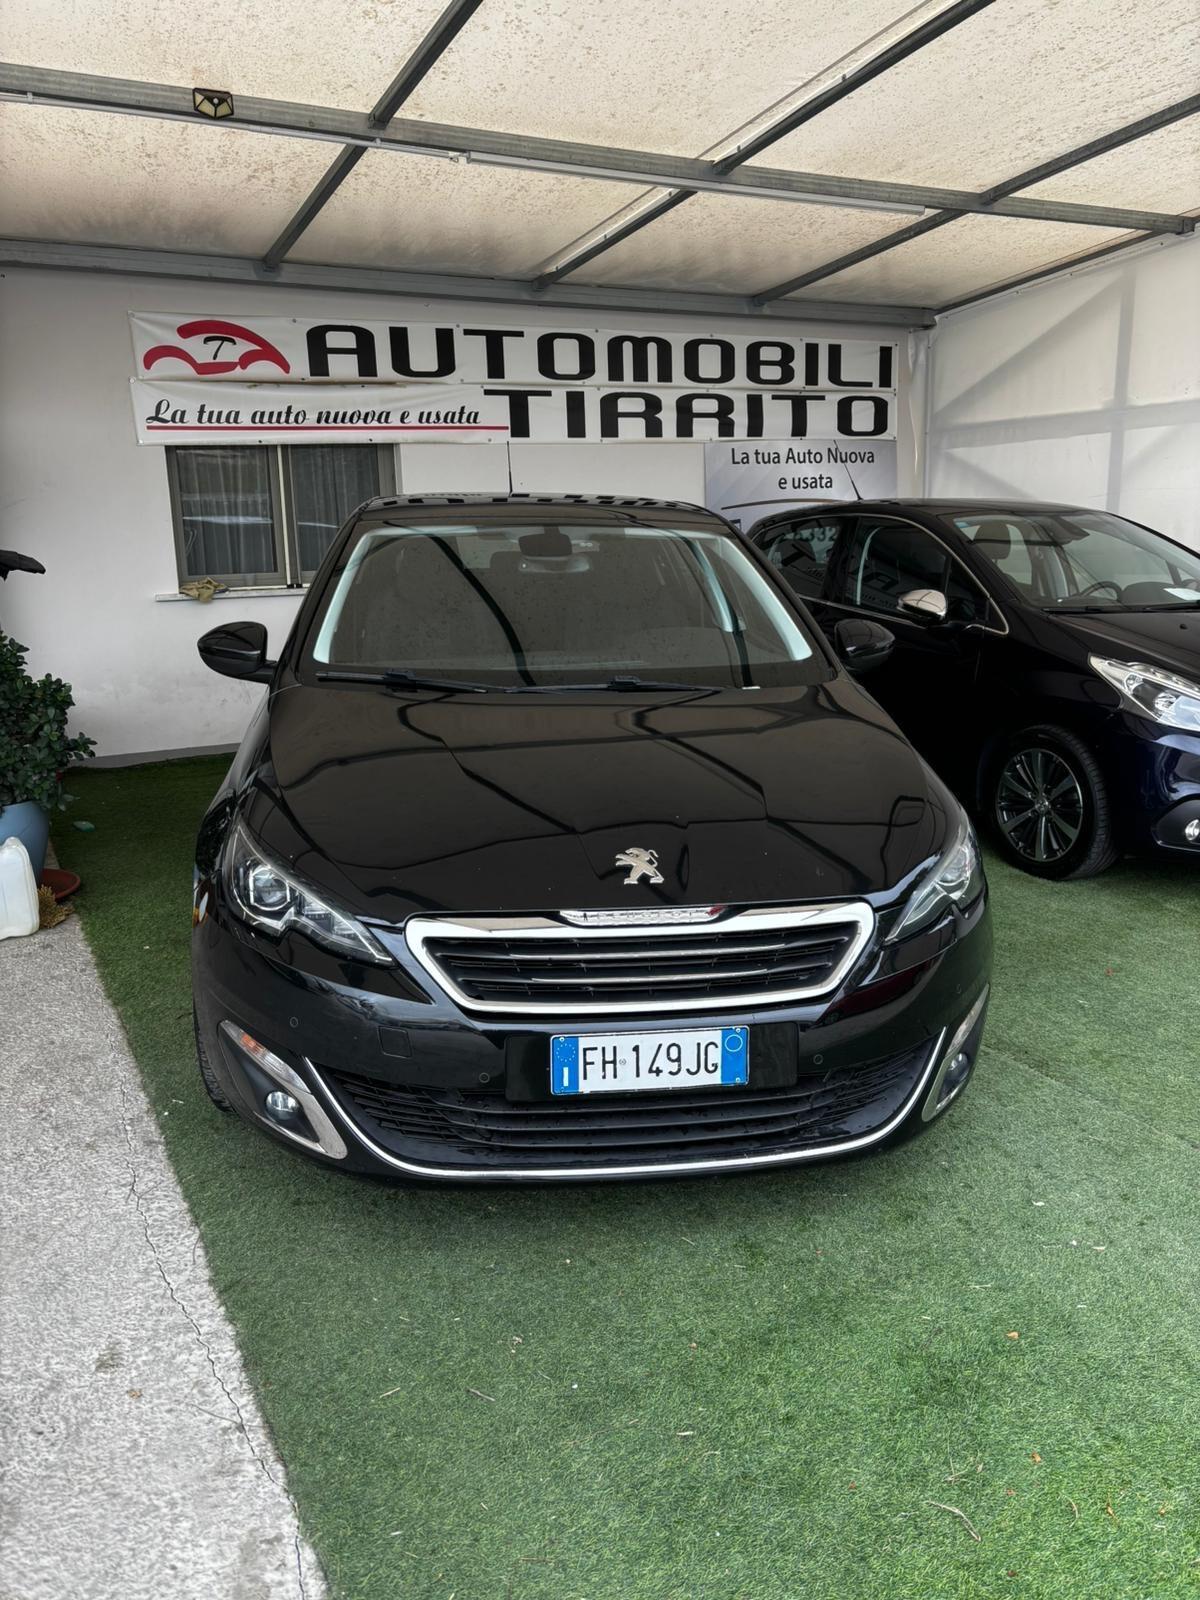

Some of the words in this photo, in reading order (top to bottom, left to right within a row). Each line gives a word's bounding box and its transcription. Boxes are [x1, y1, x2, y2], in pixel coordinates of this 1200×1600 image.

[305, 324, 893, 388] AUTOMOBILI
[145, 398, 188, 425] La
[197, 403, 242, 425] tua
[250, 405, 309, 425] auto
[316, 409, 393, 425] nuova
[399, 410, 412, 425] e
[418, 405, 481, 425] usata
[483, 388, 889, 439] TIRRITO
[731, 447, 750, 465] La
[754, 449, 781, 465] tua
[785, 447, 823, 464] Auto
[827, 446, 875, 464] Nuova
[778, 477, 788, 490] e
[792, 474, 834, 490] usata
[582, 1045, 618, 1081] FH
[632, 1041, 719, 1078] 149JG
